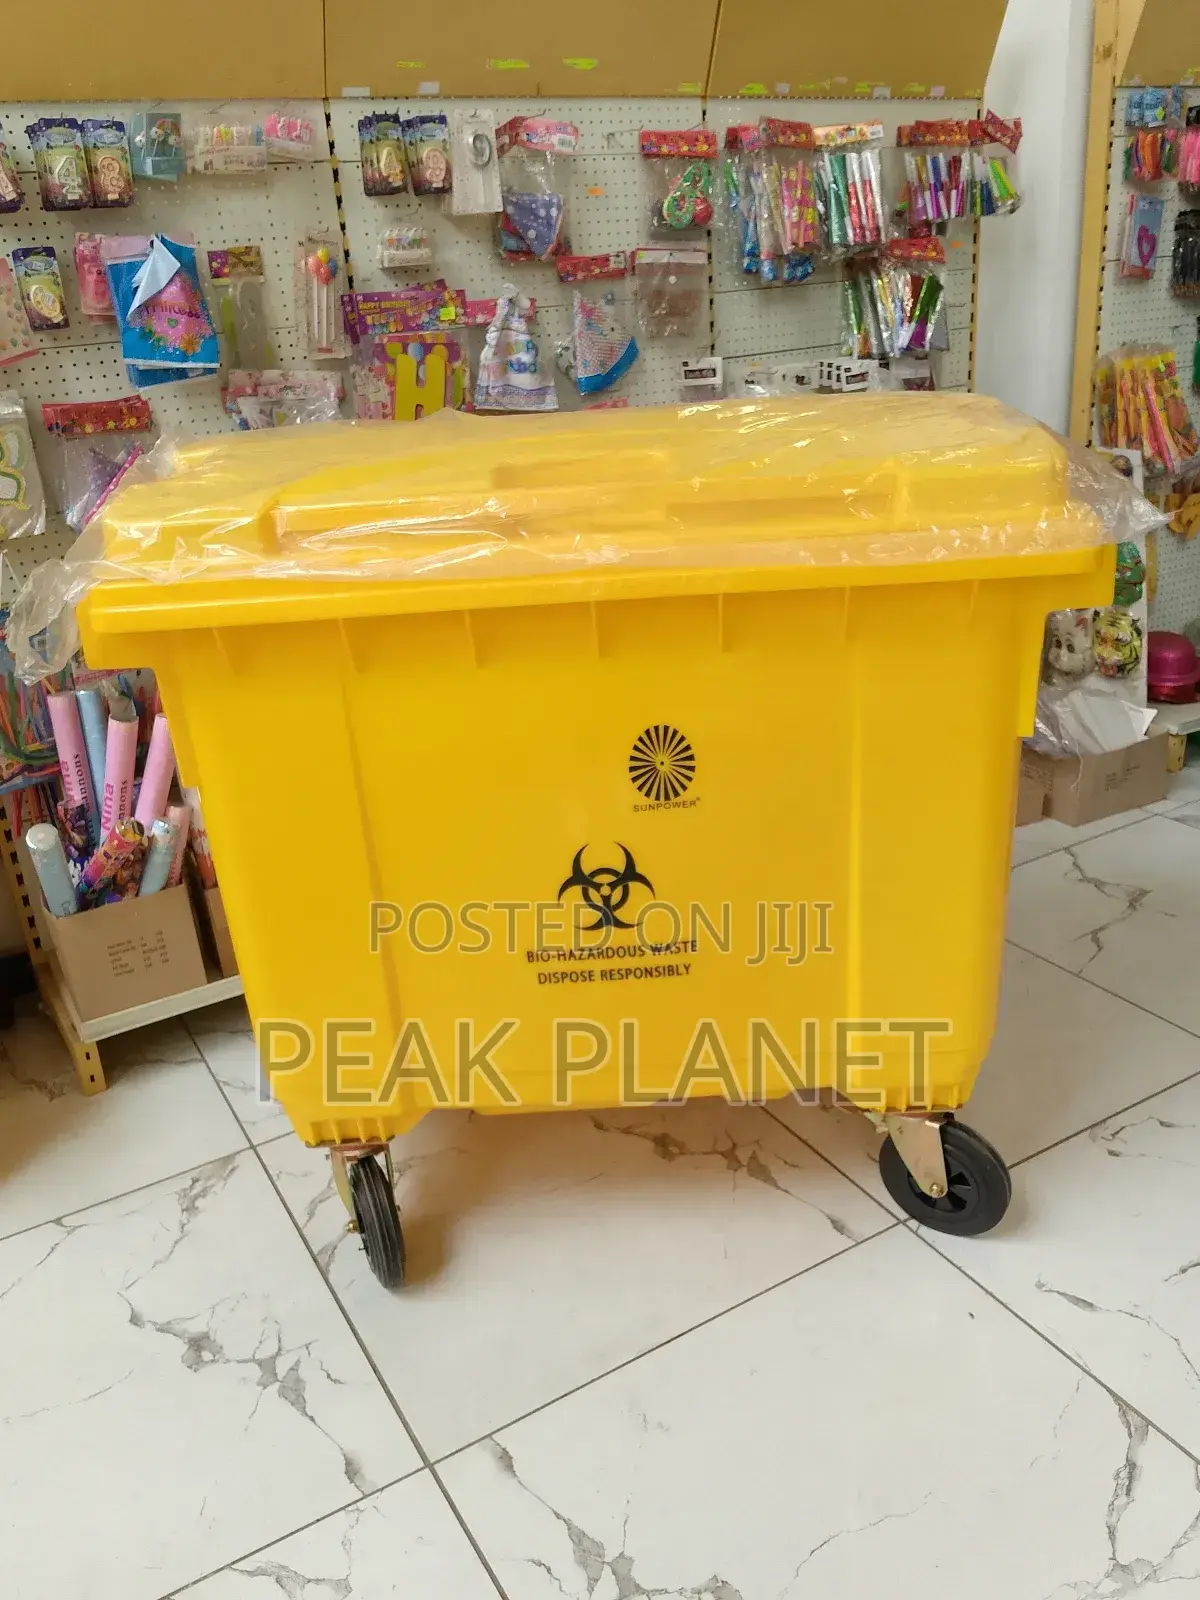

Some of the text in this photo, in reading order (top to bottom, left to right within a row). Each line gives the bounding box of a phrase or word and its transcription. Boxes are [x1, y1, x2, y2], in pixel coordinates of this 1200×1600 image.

[101, 783, 115, 832] Nina
[633, 800, 697, 813] SUNPOWER
[526, 940, 698, 963] BIO-HAZARDOUS WASTE
[537, 963, 693, 985] DISPOSE RESPONSIBLY
